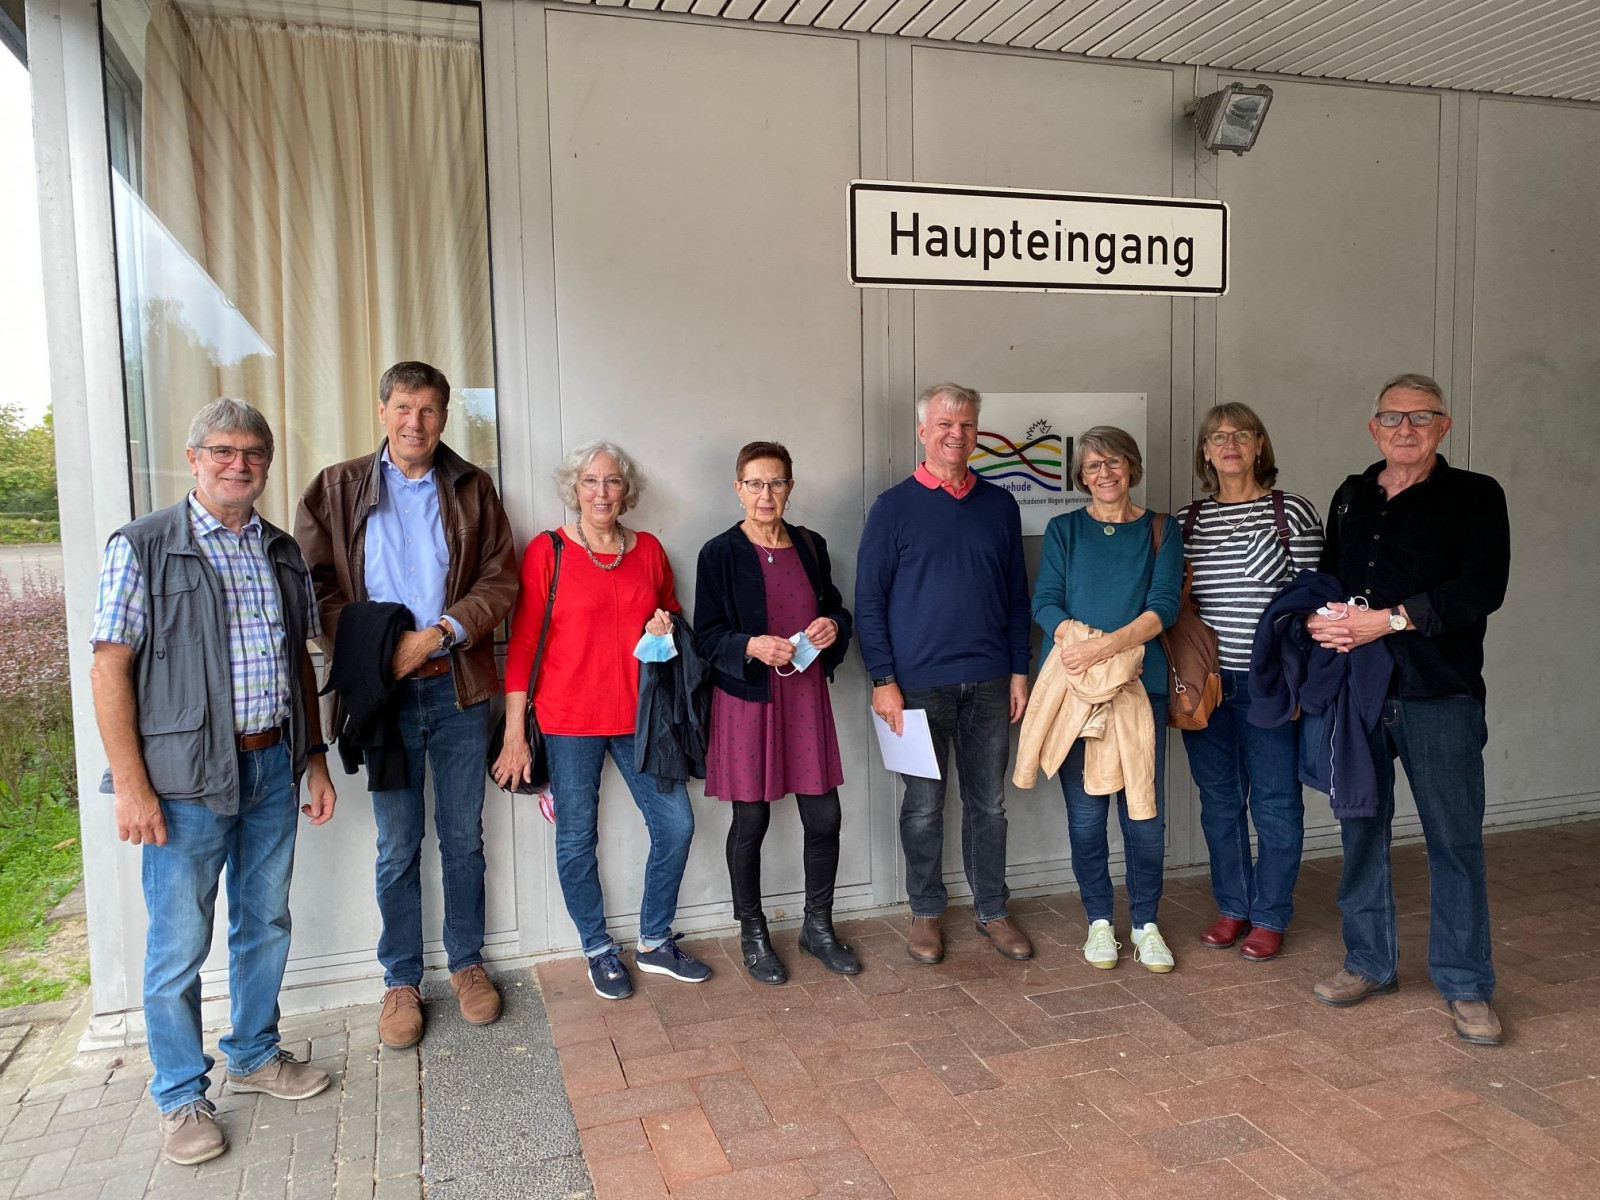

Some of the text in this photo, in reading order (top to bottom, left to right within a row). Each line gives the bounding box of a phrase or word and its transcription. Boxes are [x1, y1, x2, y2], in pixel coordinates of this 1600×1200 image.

[890, 211, 1194, 278] Haupteingang
[1001, 481, 1031, 491] tehude
[1047, 497, 1064, 505] Wegen
